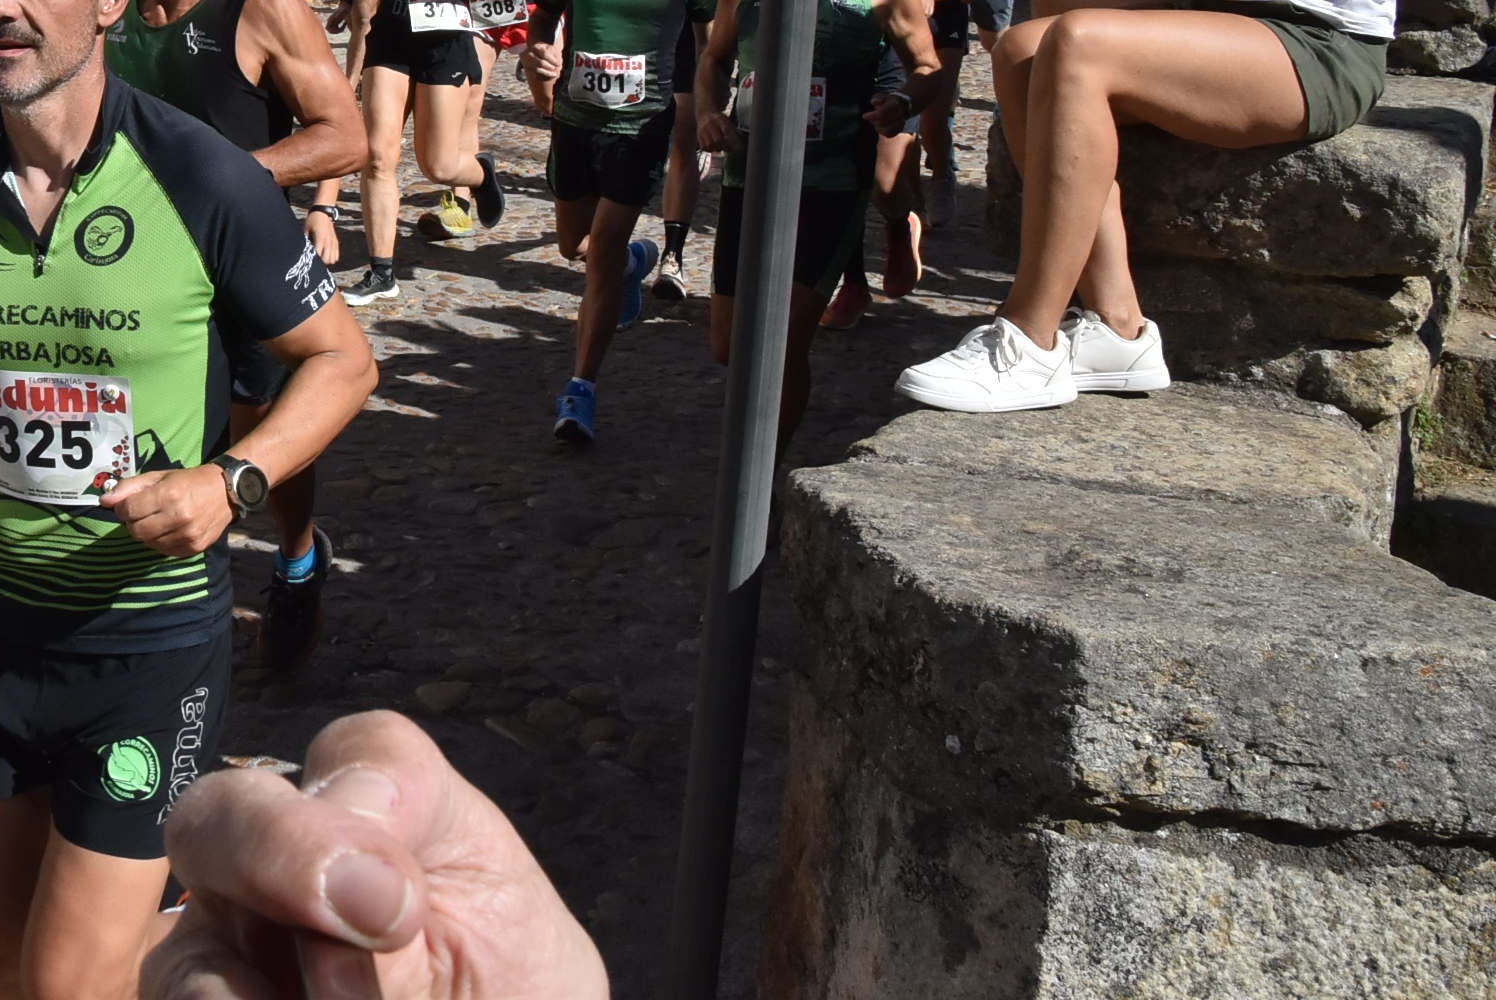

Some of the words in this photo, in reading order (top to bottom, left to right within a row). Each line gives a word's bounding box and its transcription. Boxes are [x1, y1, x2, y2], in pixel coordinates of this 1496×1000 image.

[481, 0, 515, 18] 308
[574, 53, 643, 71] bedunia
[583, 72, 626, 94] 301
